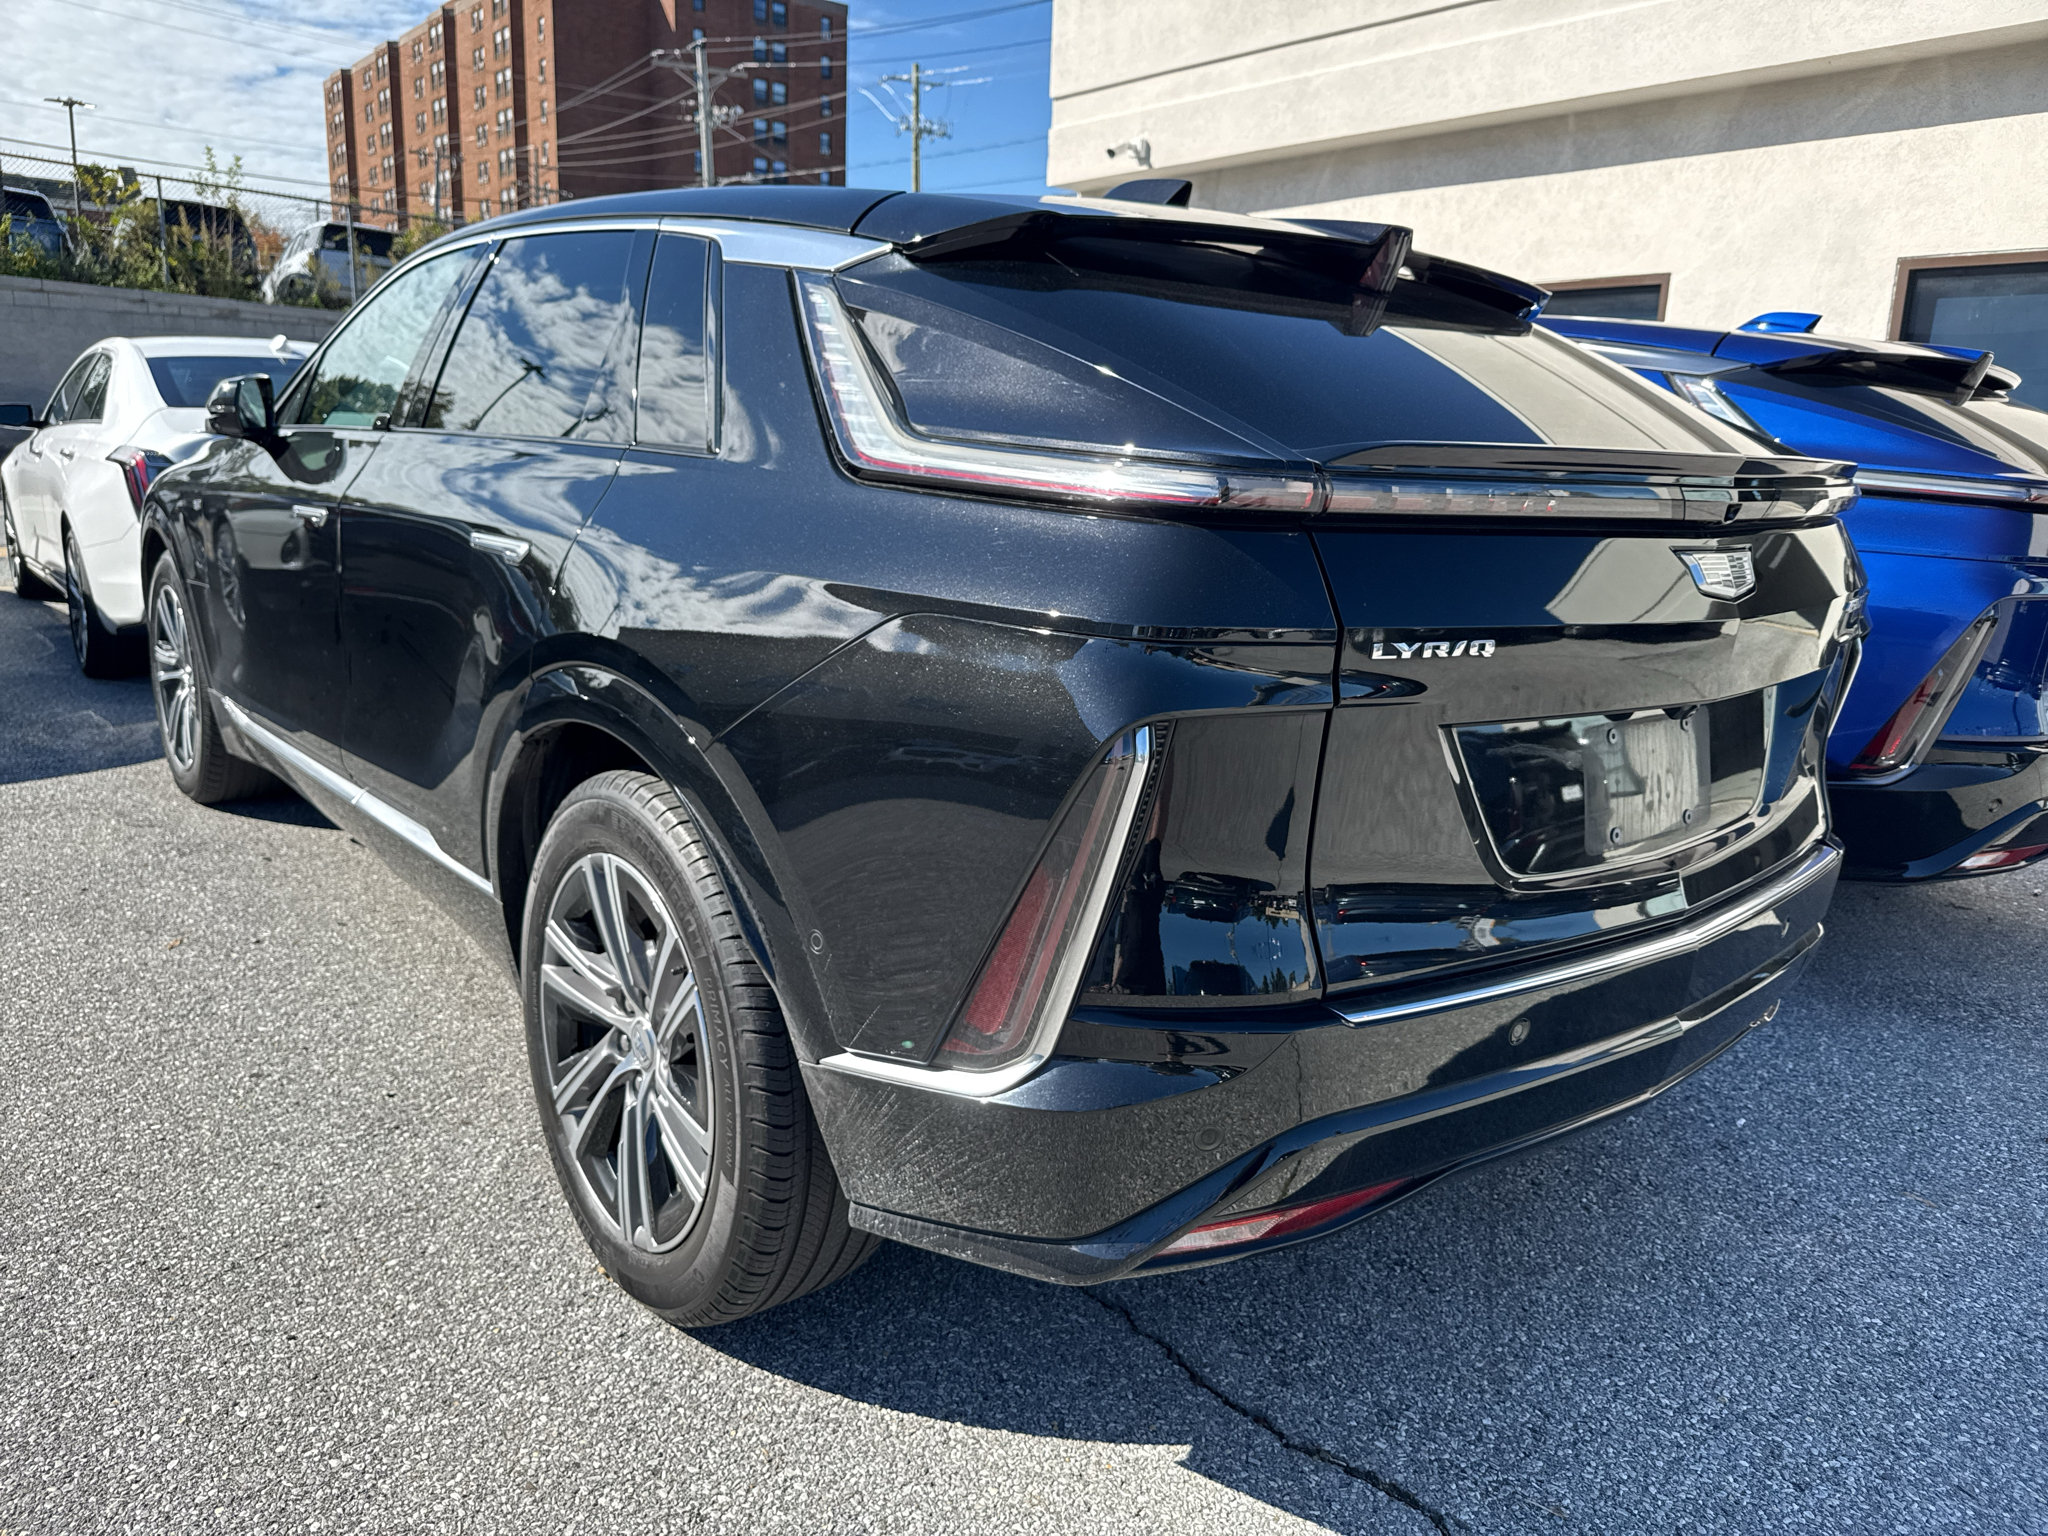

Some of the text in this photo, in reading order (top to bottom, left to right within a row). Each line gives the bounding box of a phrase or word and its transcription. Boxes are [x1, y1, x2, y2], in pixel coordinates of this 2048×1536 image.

[1371, 638, 1496, 660] LYRIQ
[705, 978, 733, 1168] PRIMACY ALL SEASON
